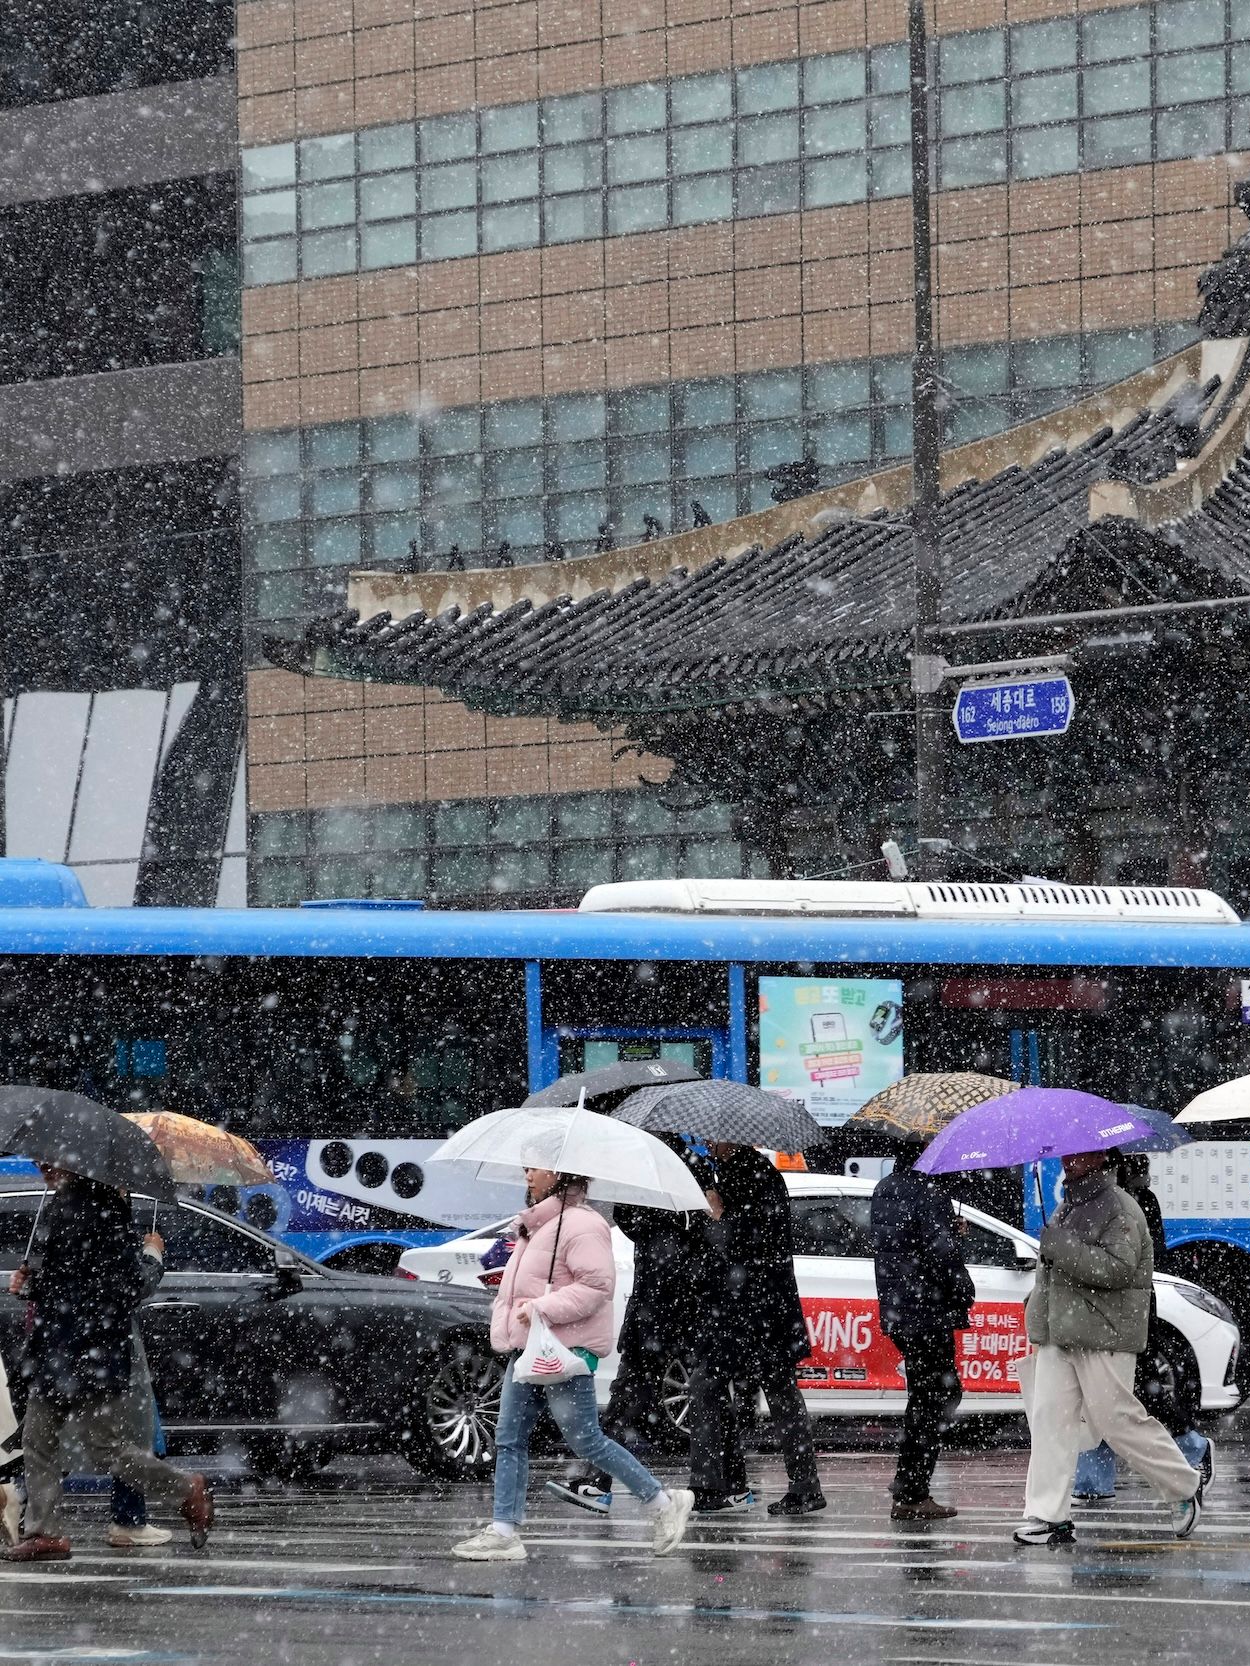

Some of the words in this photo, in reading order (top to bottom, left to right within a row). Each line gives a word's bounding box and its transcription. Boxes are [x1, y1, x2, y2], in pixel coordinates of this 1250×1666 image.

[991, 688, 1036, 713] 세종대로
[1050, 697, 1068, 714] 158
[960, 706, 976, 723] 162
[961, 1333, 980, 1355] 탈
[960, 1360, 1003, 1380] 10%
